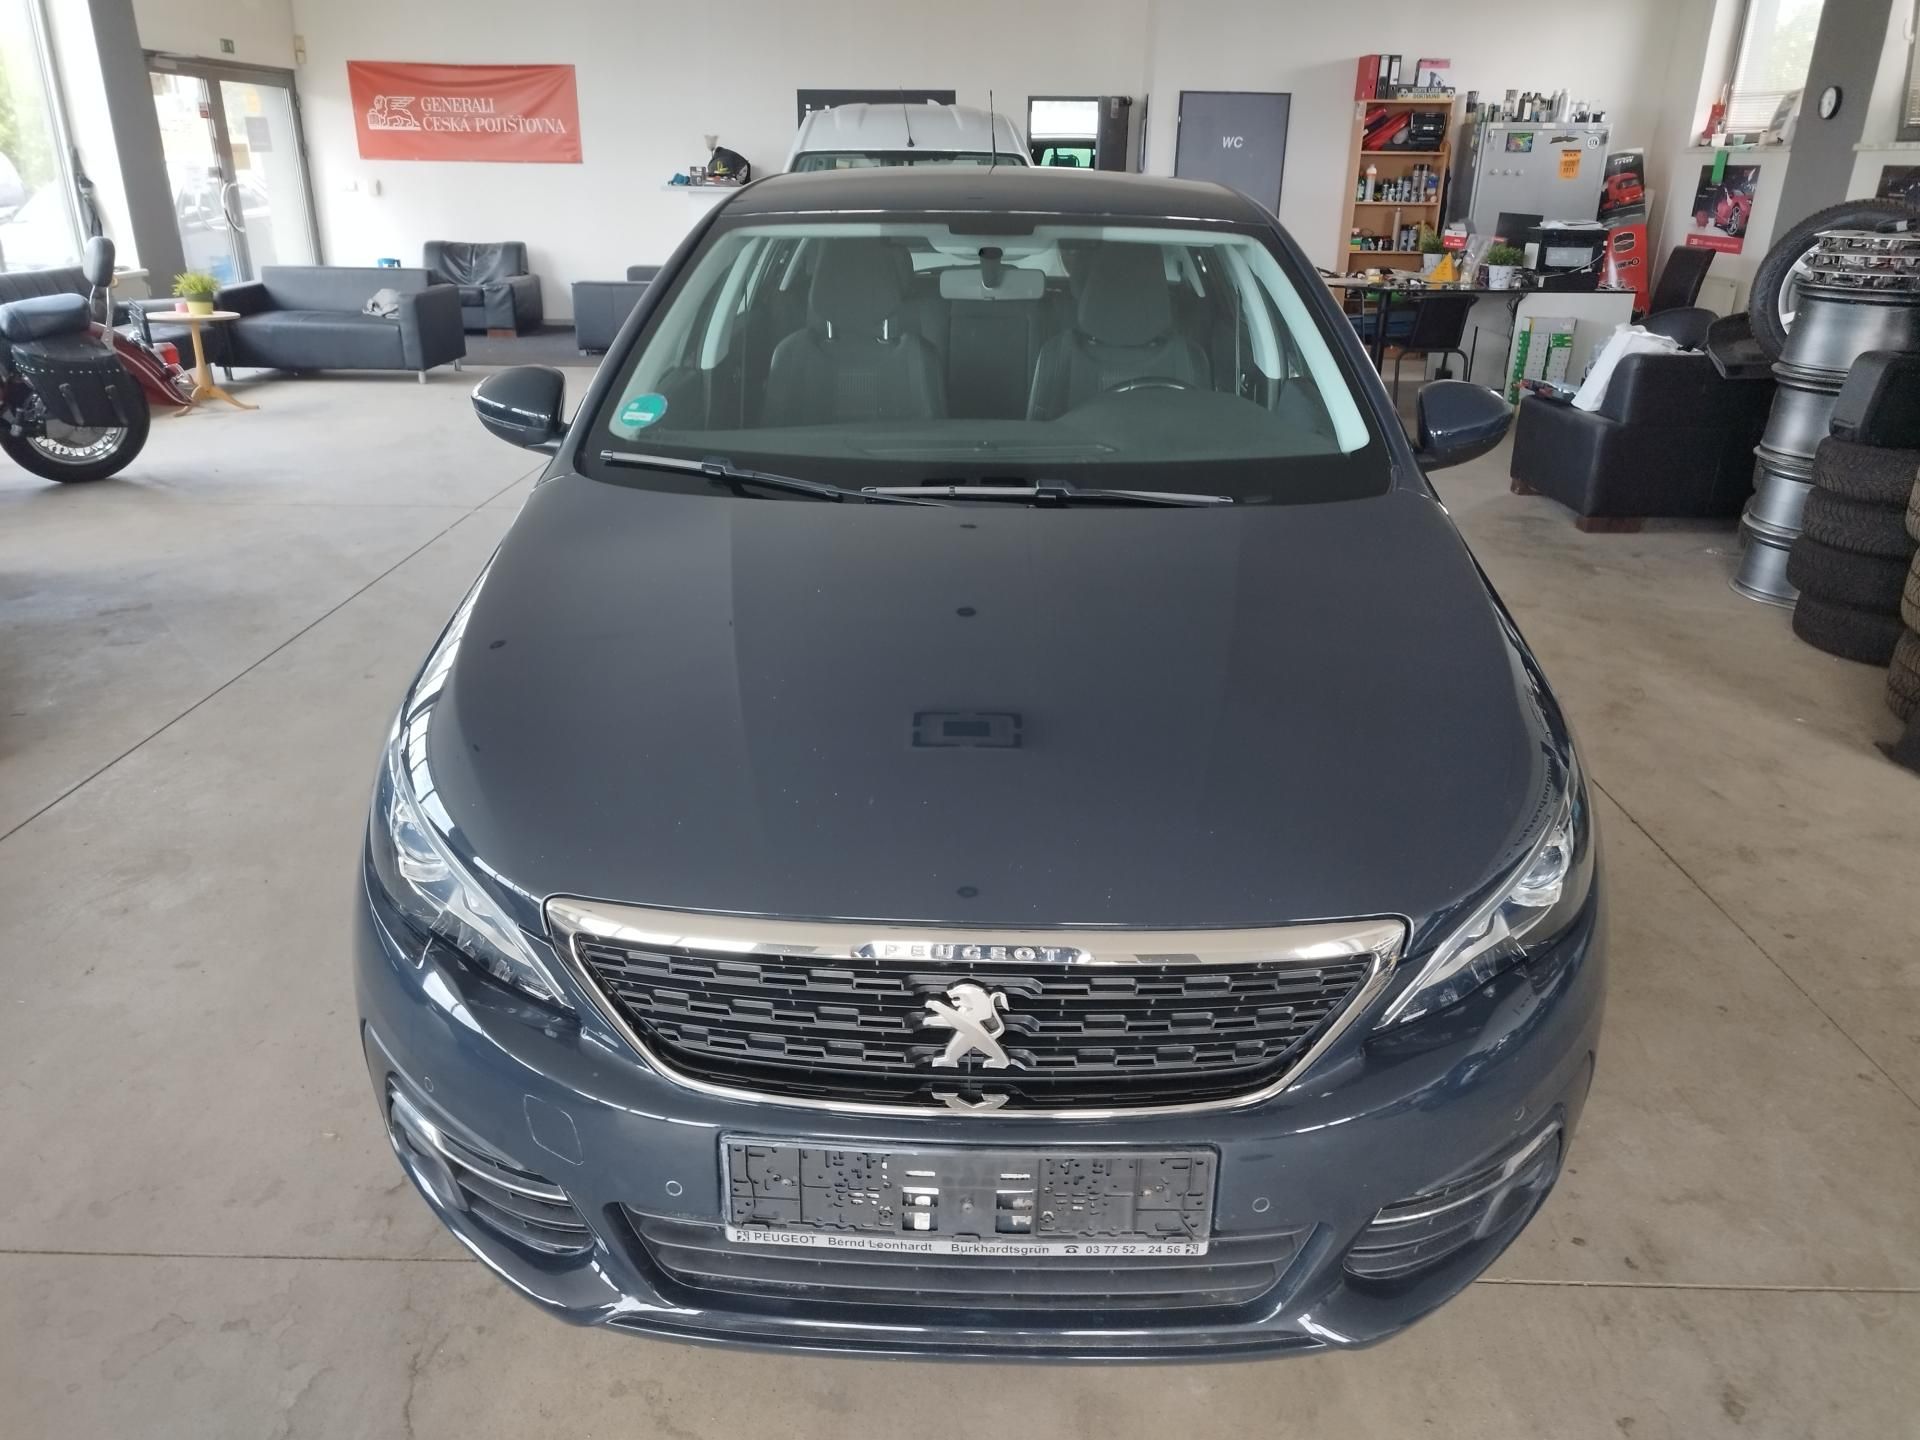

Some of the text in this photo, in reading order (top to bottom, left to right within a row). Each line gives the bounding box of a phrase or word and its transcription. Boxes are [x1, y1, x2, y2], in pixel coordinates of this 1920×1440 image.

[420, 96, 495, 113] GENERALI
[422, 113, 567, 134] ČESKÁ POJIŠŤOVNA
[1222, 135, 1244, 149] WC
[884, 943, 1060, 962] PEUGEOT
[754, 1231, 817, 1244] PEUGEOT
[828, 1236, 865, 1248] Bernd
[869, 1239, 933, 1252] Leonhardt
[951, 1243, 1050, 1256] Burkhardtsgrün
[1085, 1245, 1100, 1254] 03
[1104, 1245, 1117, 1254] 77
[1121, 1245, 1136, 1254] 52
[1148, 1245, 1162, 1254] 24
[1166, 1244, 1181, 1254] 56
